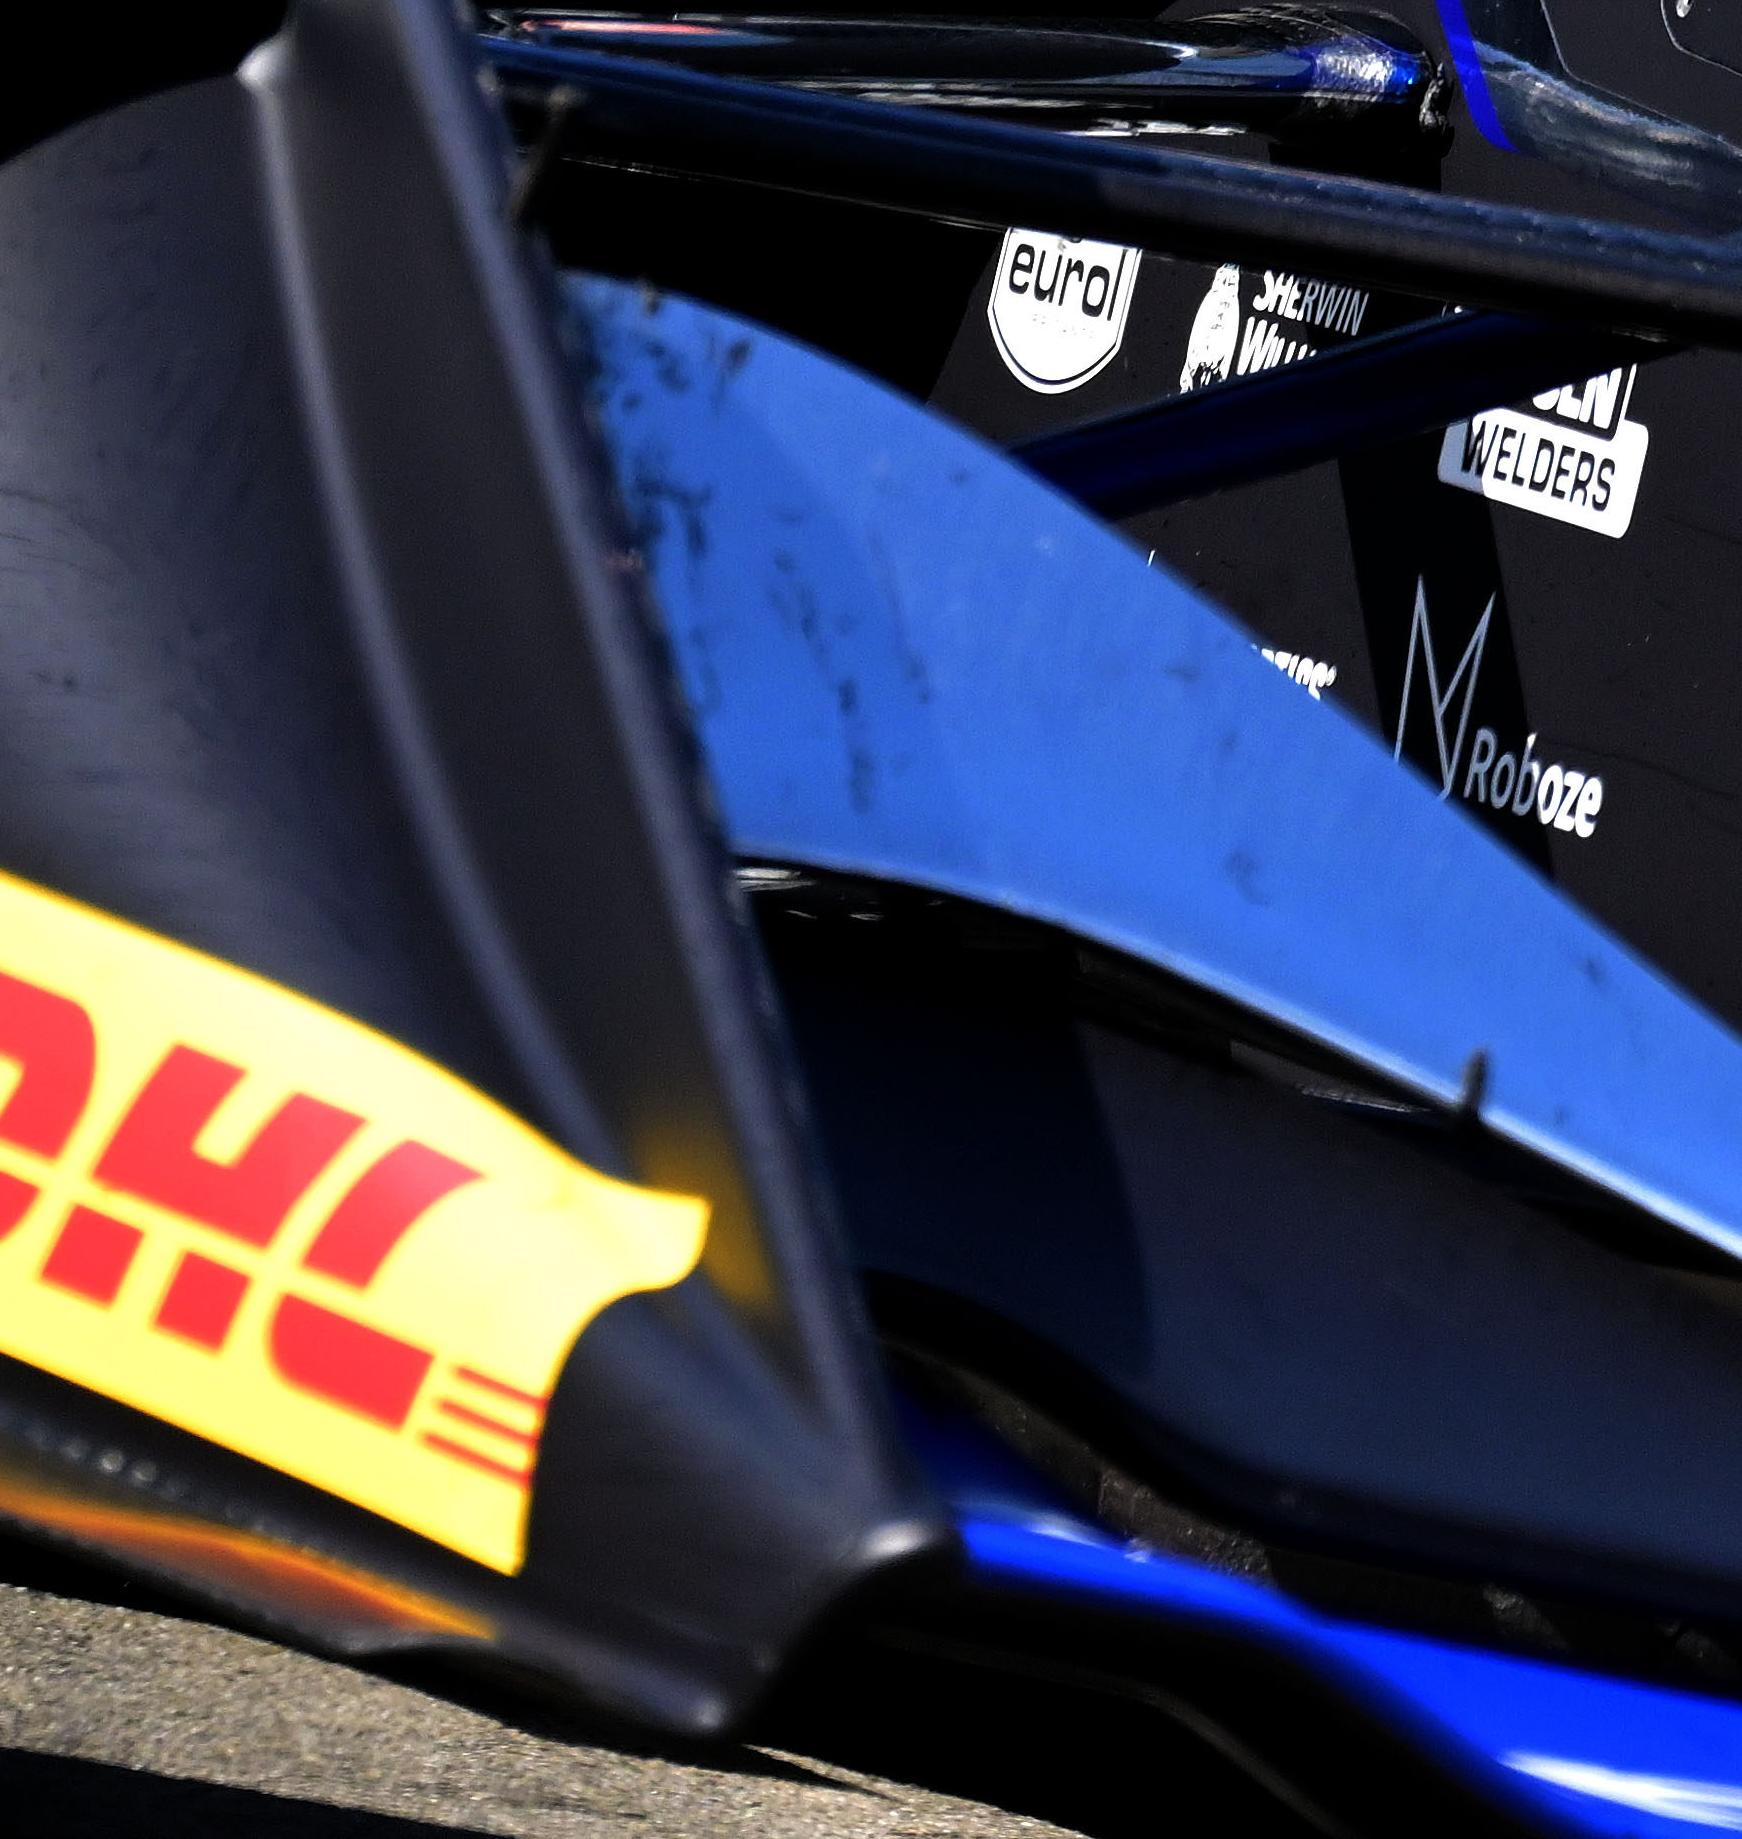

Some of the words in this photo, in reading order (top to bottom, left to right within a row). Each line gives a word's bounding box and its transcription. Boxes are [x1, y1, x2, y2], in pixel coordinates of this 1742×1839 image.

[1008, 243, 1129, 322] eurol
[1252, 269, 1370, 337] SHERWIN
[1461, 417, 1616, 512] WELDERS
[1463, 726, 1603, 839] Roboze
